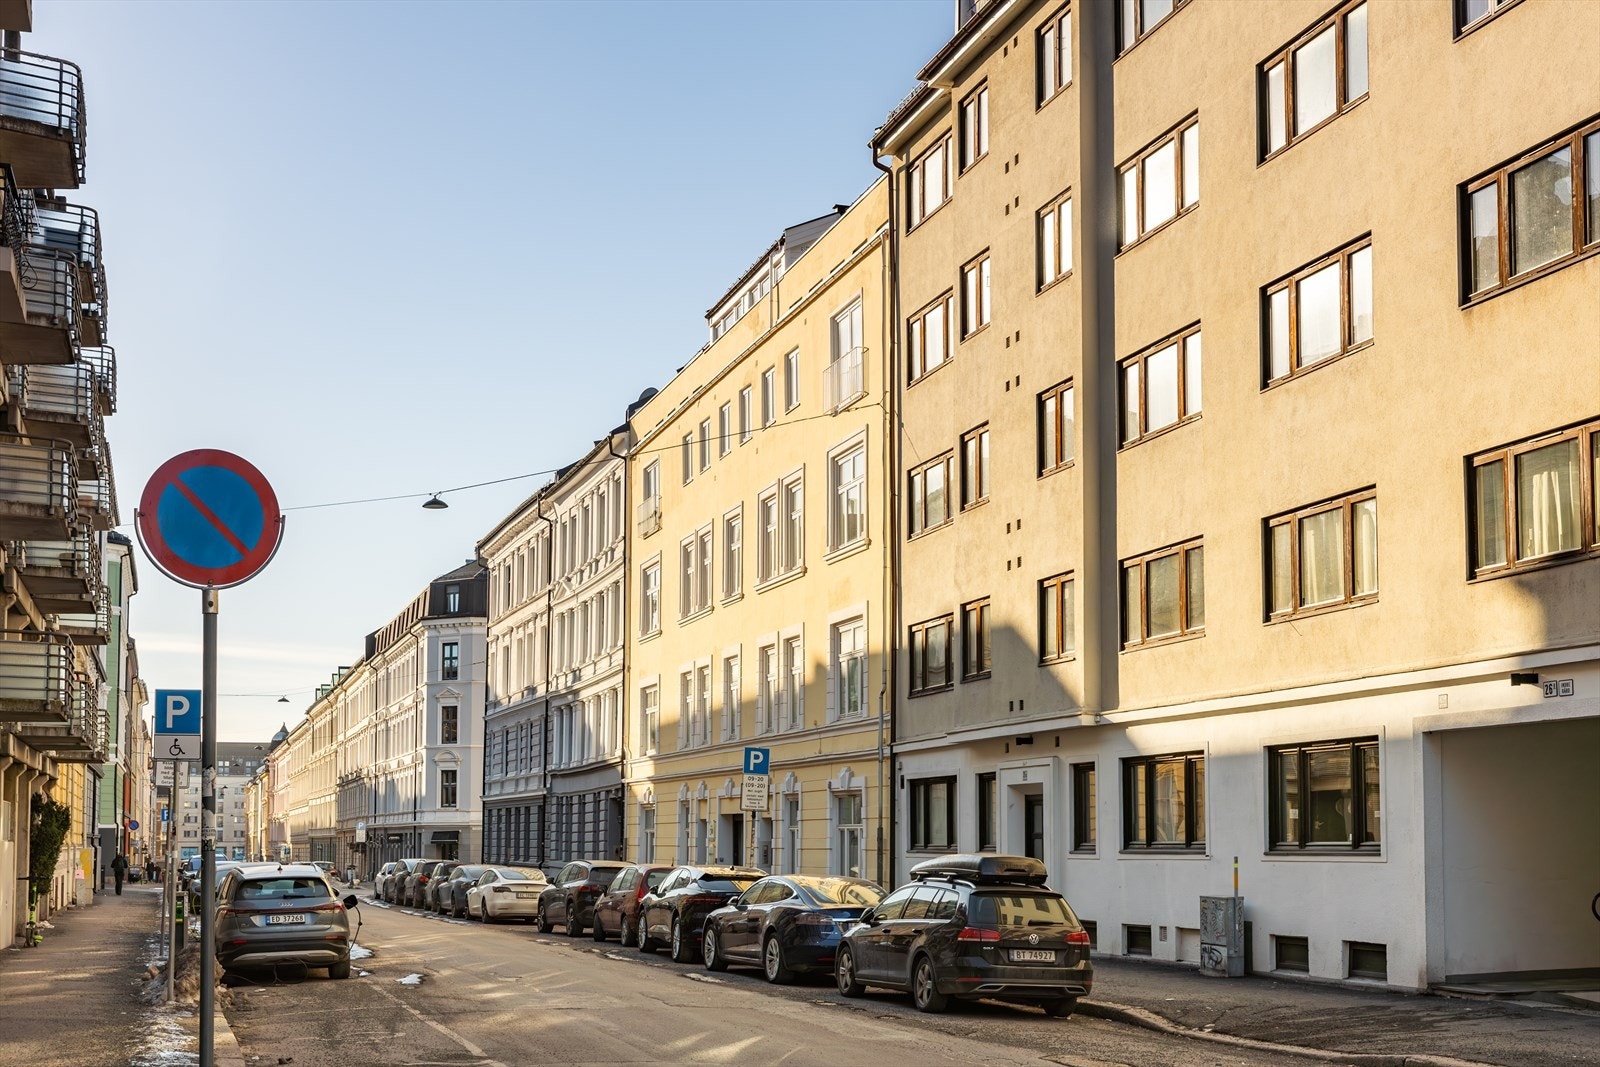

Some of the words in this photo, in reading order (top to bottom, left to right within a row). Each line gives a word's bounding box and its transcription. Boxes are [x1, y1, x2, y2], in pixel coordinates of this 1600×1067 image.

[166, 695, 190, 728] P
[750, 751, 764, 771] P
[1016, 951, 1026, 959] BT
[1029, 951, 1053, 960] 74927
